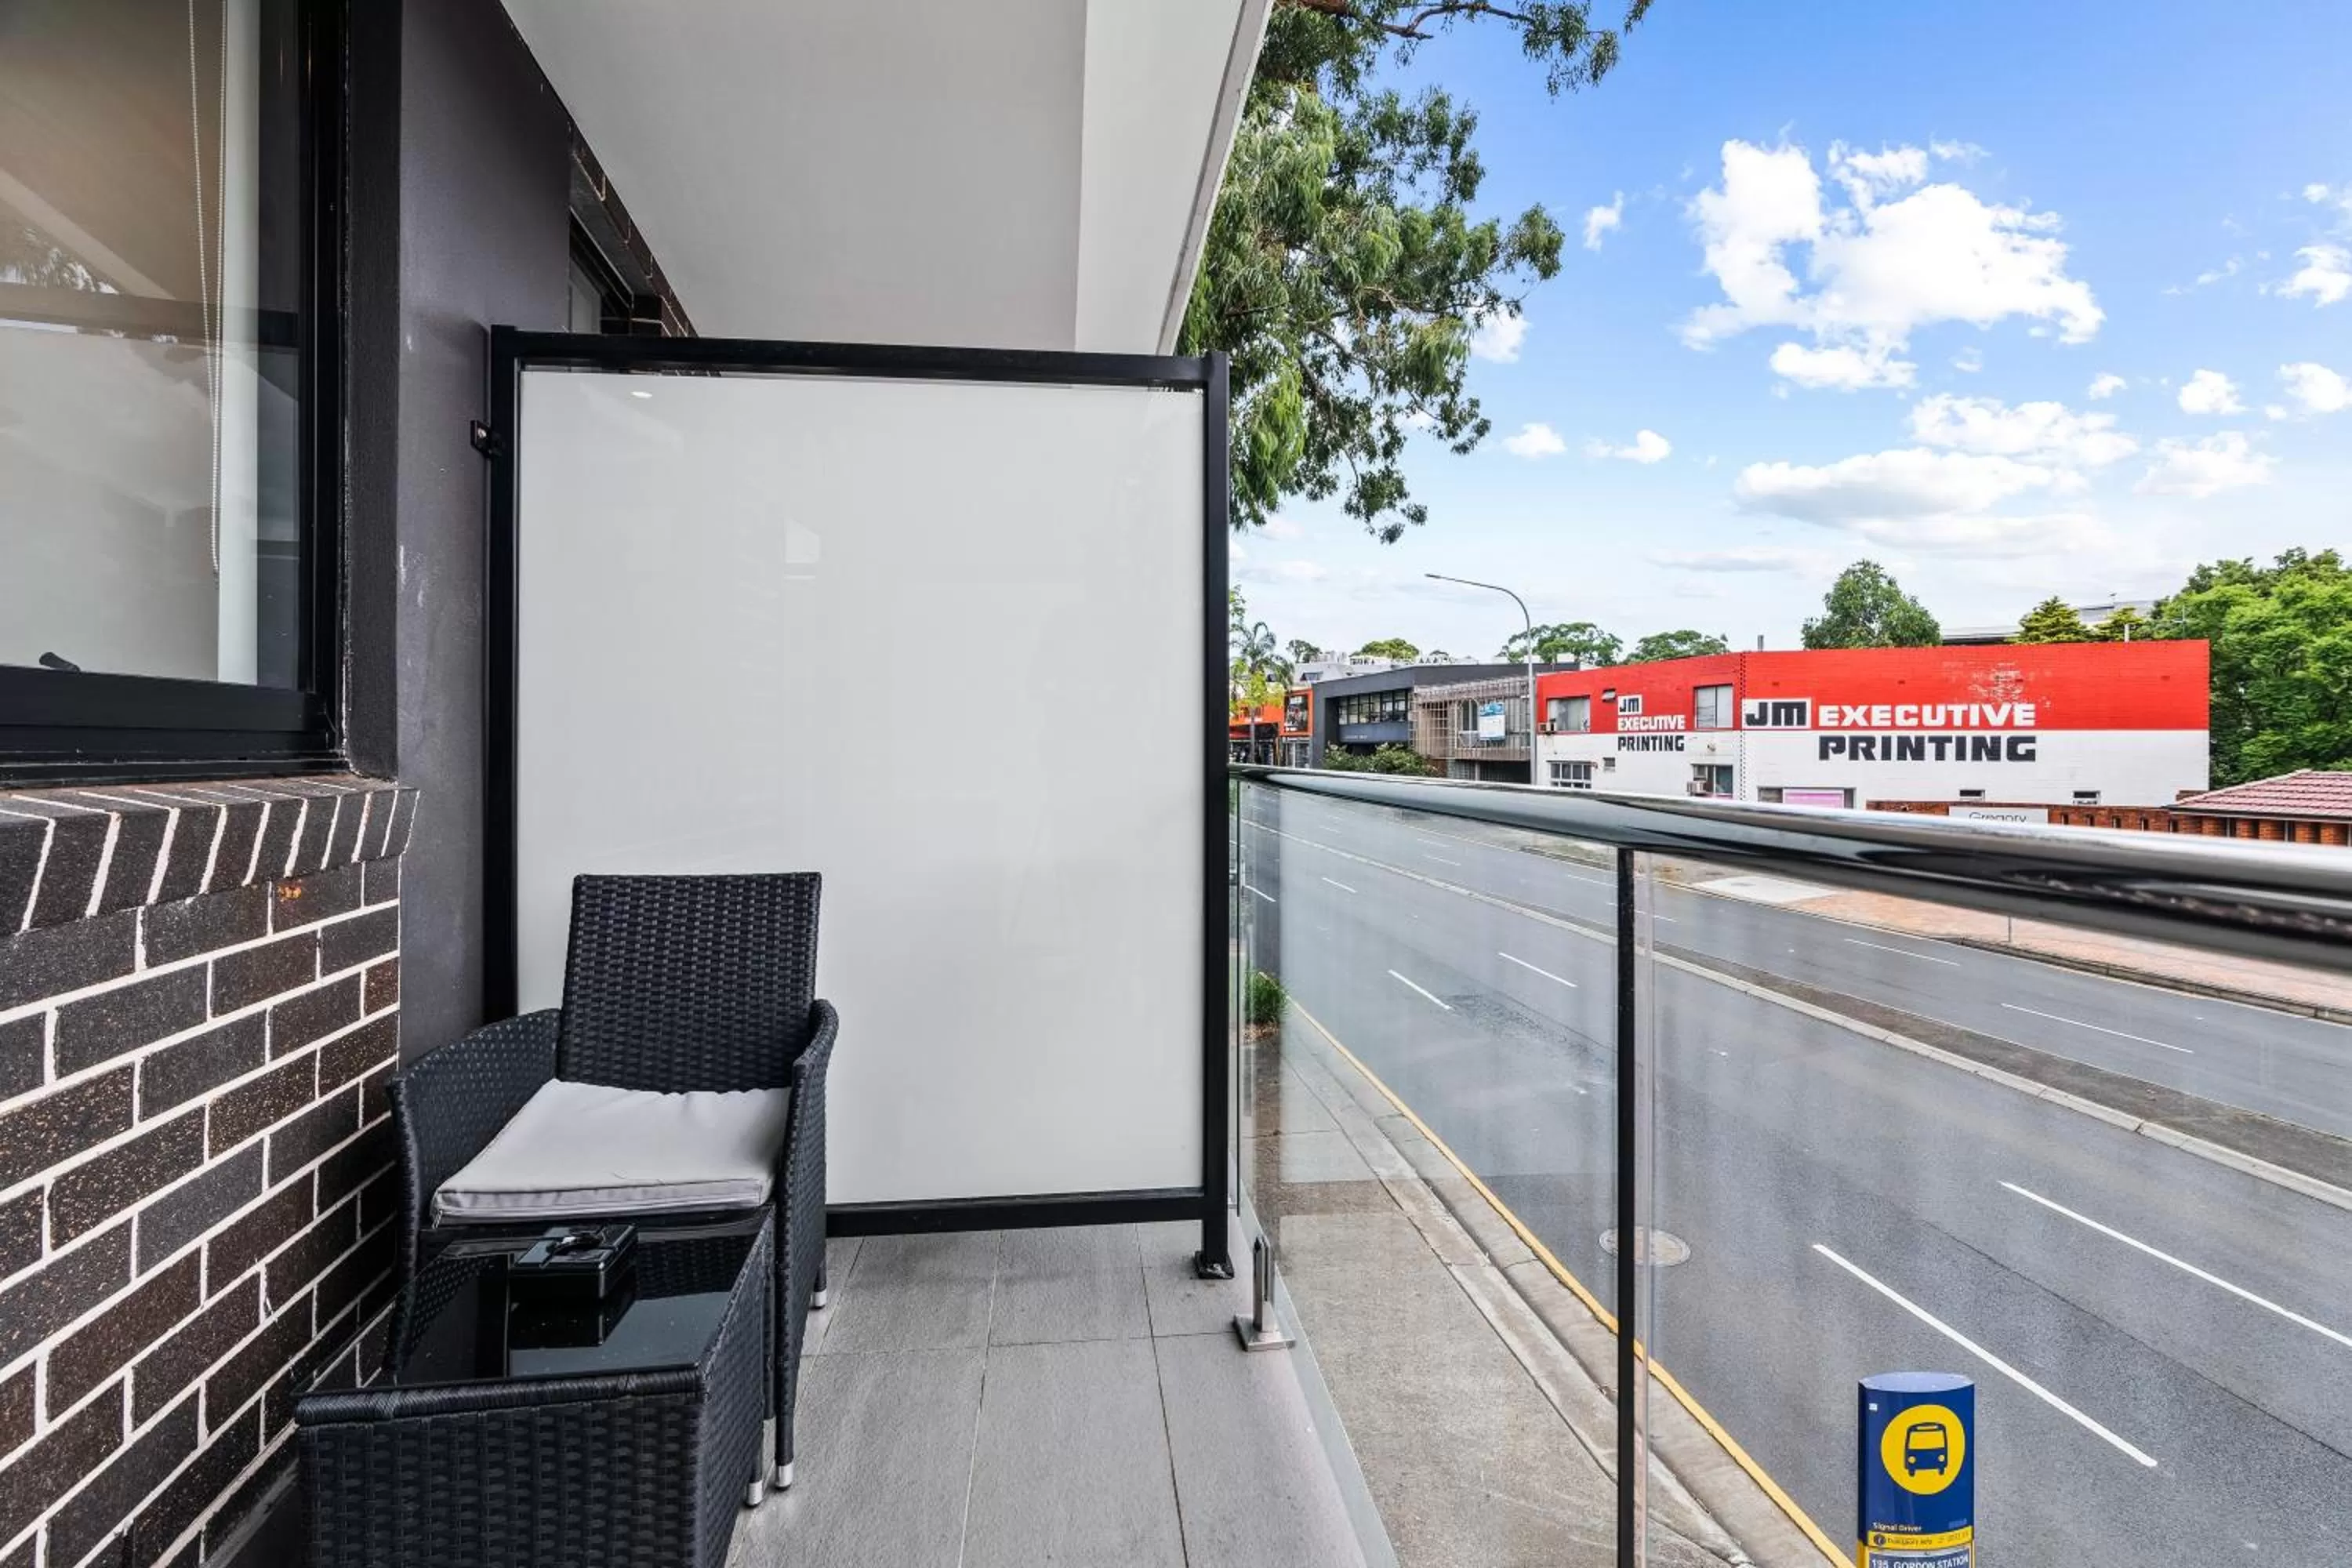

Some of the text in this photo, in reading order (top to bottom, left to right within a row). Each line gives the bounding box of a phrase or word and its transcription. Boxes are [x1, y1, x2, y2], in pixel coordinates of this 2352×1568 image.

[1618, 697, 1640, 713] JM
[1617, 714, 1685, 731] EXECUTIVE
[1744, 701, 2036, 728] JM EXECUTIVE
[1617, 735, 1685, 752] PRINTING
[1818, 735, 2037, 762] PRINTING
